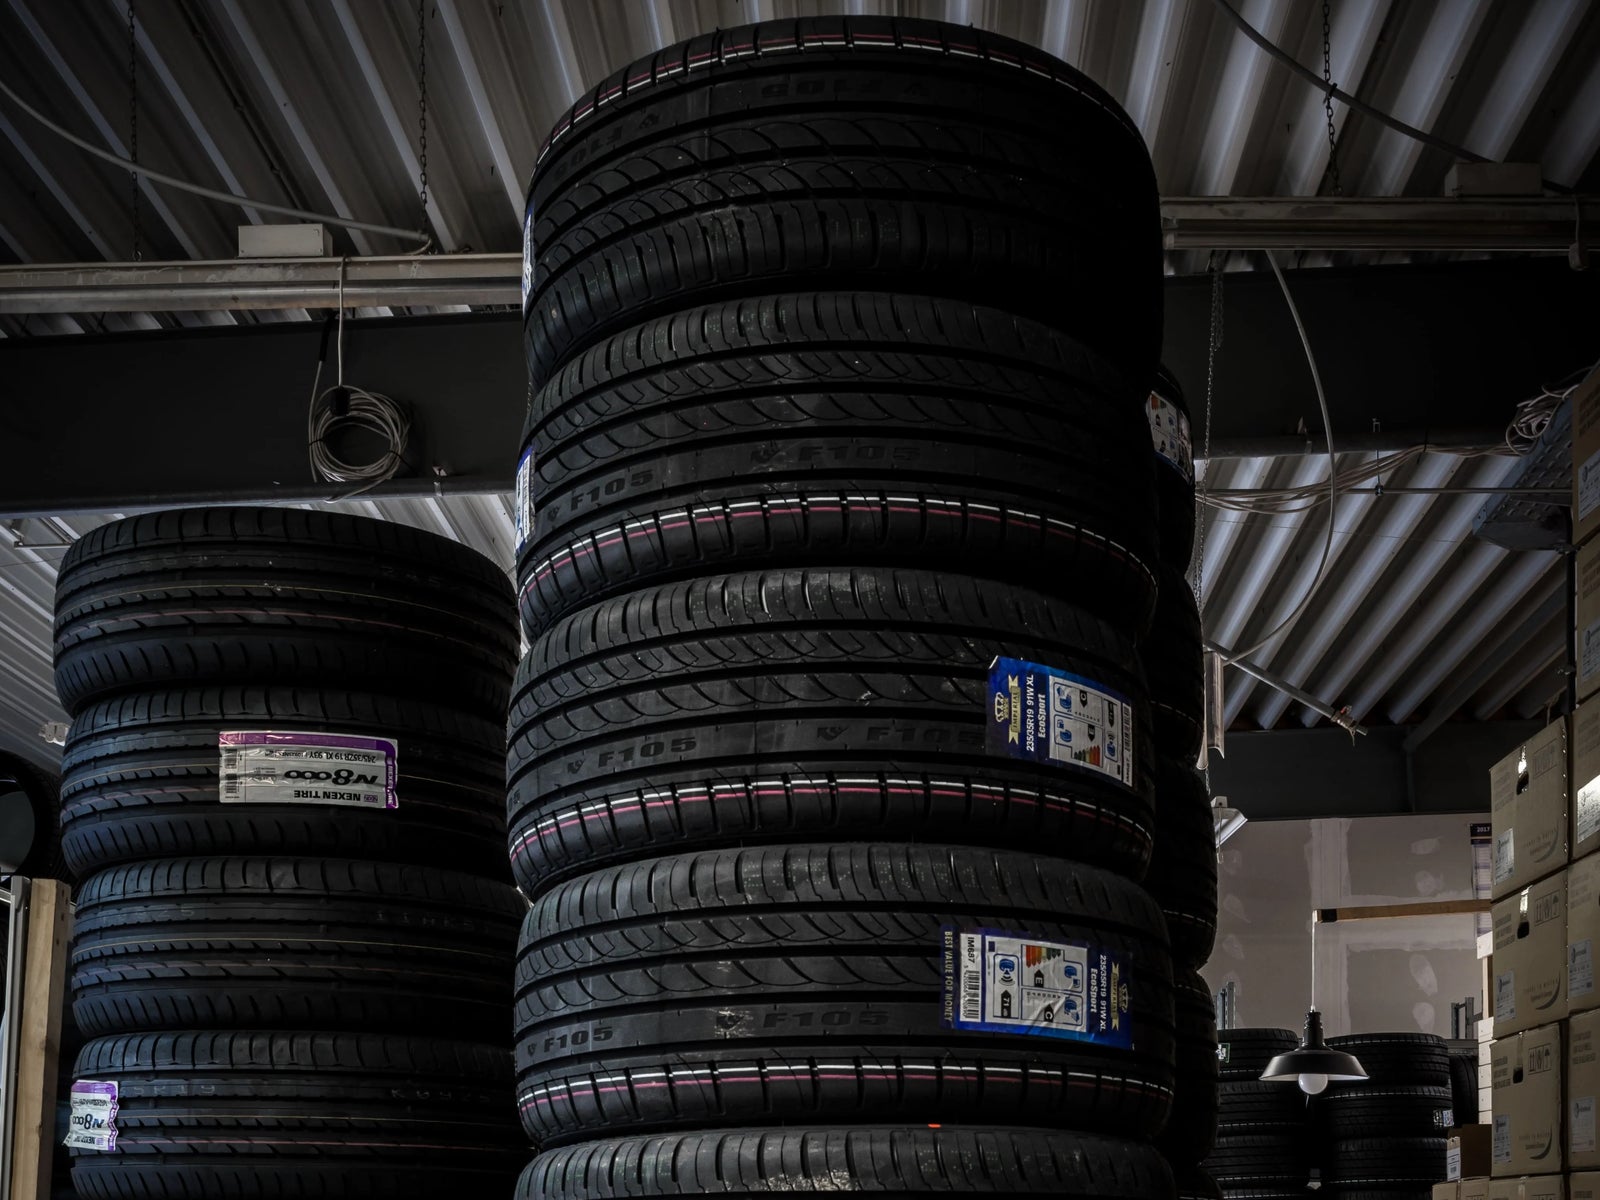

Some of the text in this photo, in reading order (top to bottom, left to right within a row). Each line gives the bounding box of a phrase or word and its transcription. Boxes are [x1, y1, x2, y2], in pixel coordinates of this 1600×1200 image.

[571, 469, 654, 511] F105
[1026, 674, 1035, 752] 235/35R19 91W XL
[1038, 694, 1047, 738] EcoSport
[309, 750, 324, 759] 93Y
[599, 737, 697, 767] F105
[284, 769, 378, 786] N8000
[294, 790, 320, 799] TIRE
[322, 791, 361, 801] NEXEN
[943, 931, 953, 1021] BEST VALUE FOR MONEY
[1090, 968, 1098, 1014] EcoSport
[763, 1011, 890, 1028] F105
[543, 1027, 614, 1053] F105
